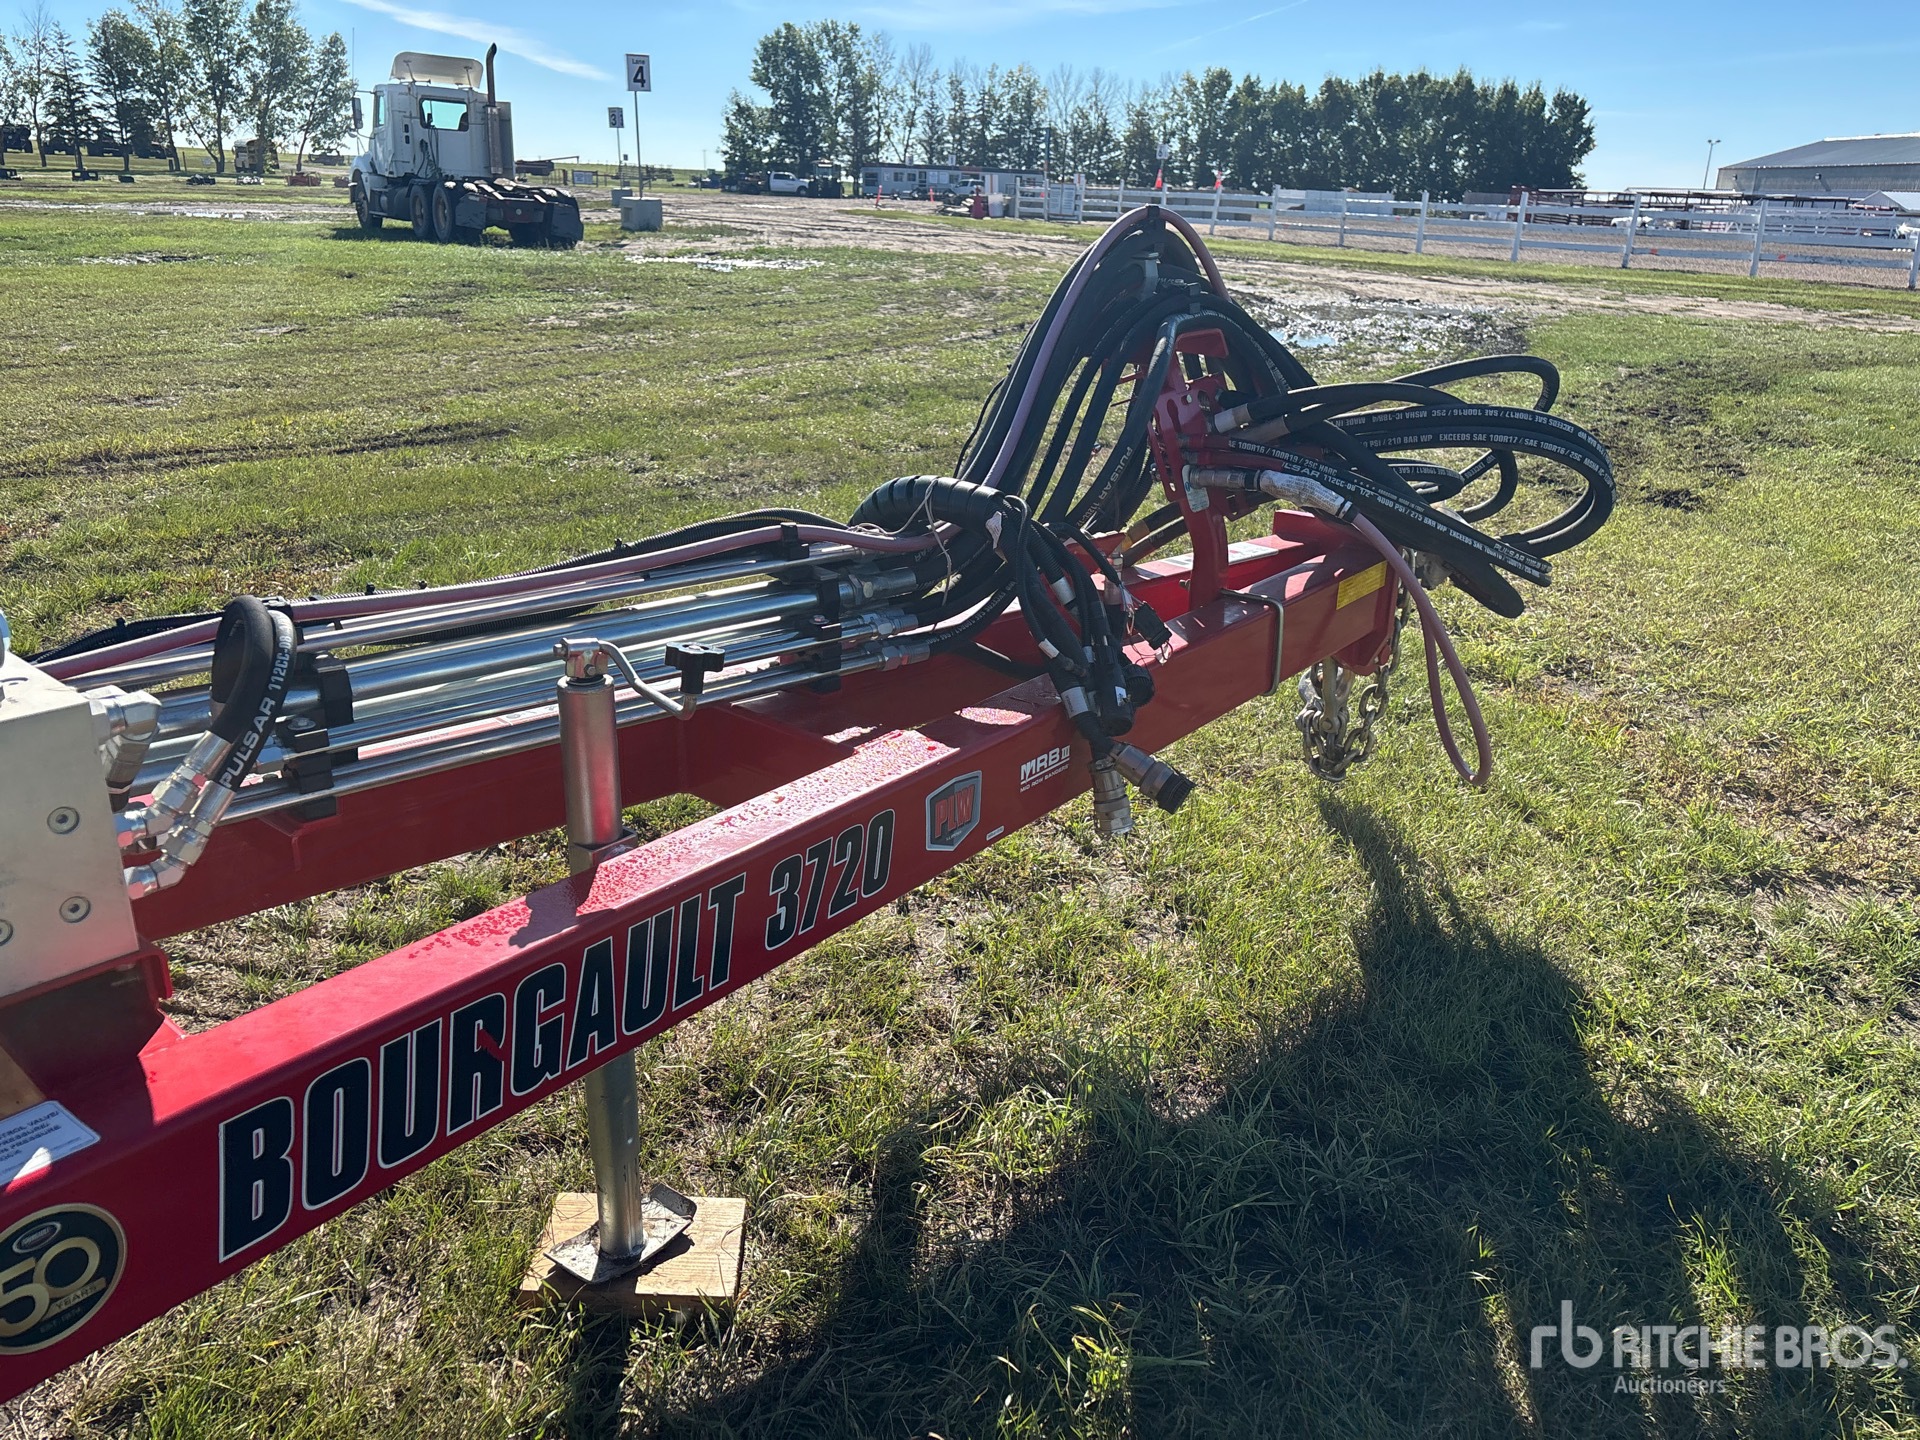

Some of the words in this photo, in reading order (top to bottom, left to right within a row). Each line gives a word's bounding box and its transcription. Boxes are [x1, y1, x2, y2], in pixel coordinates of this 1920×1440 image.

[632, 66, 646, 88] 4
[610, 113, 617, 126] 3
[1345, 417, 1366, 426] MADE
[1405, 410, 1428, 420] MSHA
[1431, 409, 1446, 417] 2SC
[1453, 408, 1482, 417] 100R16
[1485, 409, 1499, 417] SAE
[1505, 411, 1533, 421] 100R17
[1535, 415, 1547, 425] SAE
[1548, 417, 1574, 434] EXCEEDS
[1238, 441, 1265, 454] 100R16
[1271, 449, 1299, 462] 100R19
[1369, 439, 1382, 448] PSI
[1387, 437, 1402, 446] 210
[1403, 435, 1418, 444] BAR
[1420, 434, 1433, 442] WP
[1439, 433, 1471, 442] EXCEEDS
[1473, 433, 1487, 441] SAE
[1489, 434, 1518, 444] 100R17
[1524, 438, 1538, 448] SAE
[1540, 441, 1567, 456] 100R16
[1569, 451, 1583, 462] 2SC
[1098, 446, 1133, 500] PULSAR
[1282, 461, 1320, 478] LSAR
[1323, 474, 1356, 492] 112CC-08
[1377, 495, 1394, 509] 4000
[1394, 502, 1406, 514] PSI
[1410, 509, 1423, 521] 275
[1423, 515, 1436, 528] BAR
[1436, 521, 1448, 533] WP
[1449, 529, 1473, 546] EXCEEDS
[1492, 543, 1525, 562] PULSAR
[218, 697, 276, 789] PULSAR
[268, 634, 293, 691] 112CC-08
[1020, 747, 1060, 781] MRB
[1031, 777, 1044, 787] ROW
[1044, 763, 1070, 781] BANDERS
[218, 871, 747, 1264] BOURGAULT
[764, 808, 897, 951] 3720
[0, 1236, 100, 1337] 50
[55, 1284, 98, 1310] YEARS
